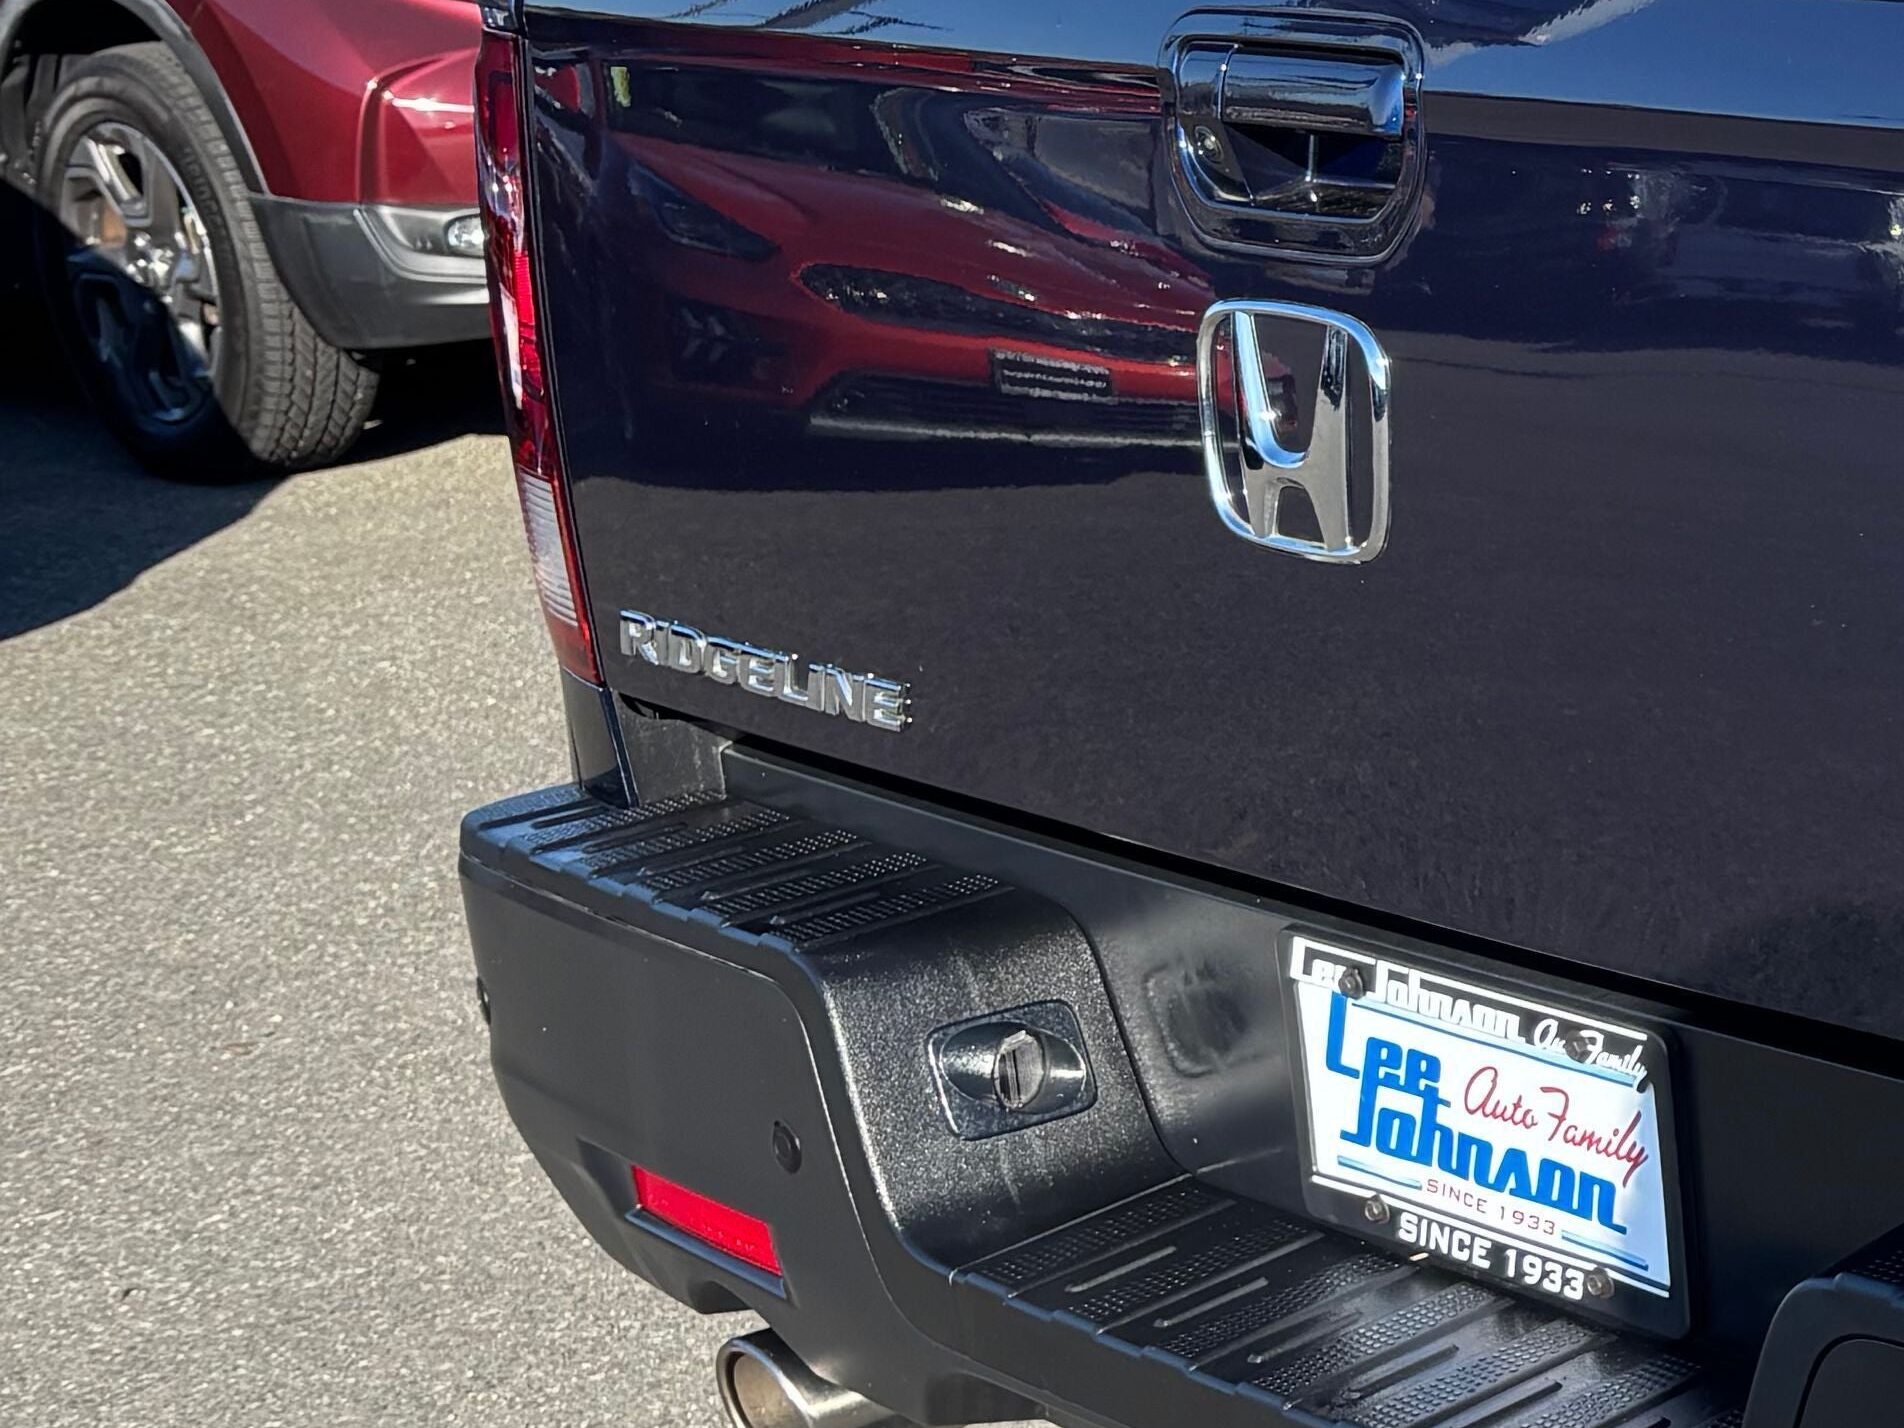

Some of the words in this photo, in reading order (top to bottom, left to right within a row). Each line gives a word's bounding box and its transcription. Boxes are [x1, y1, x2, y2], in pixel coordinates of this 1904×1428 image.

[618, 608, 912, 732] RIDGELINE
[1326, 991, 1442, 1092] Lee
[1340, 1077, 1627, 1234] Johnson
[1464, 1066, 1538, 1129] Auto
[1540, 1086, 1649, 1187] Family
[1397, 1211, 1492, 1269] SINCE
[1504, 1249, 1584, 1301] 1933
[1426, 1178, 1487, 1214] SINCE
[1499, 1205, 1556, 1236] 1933
